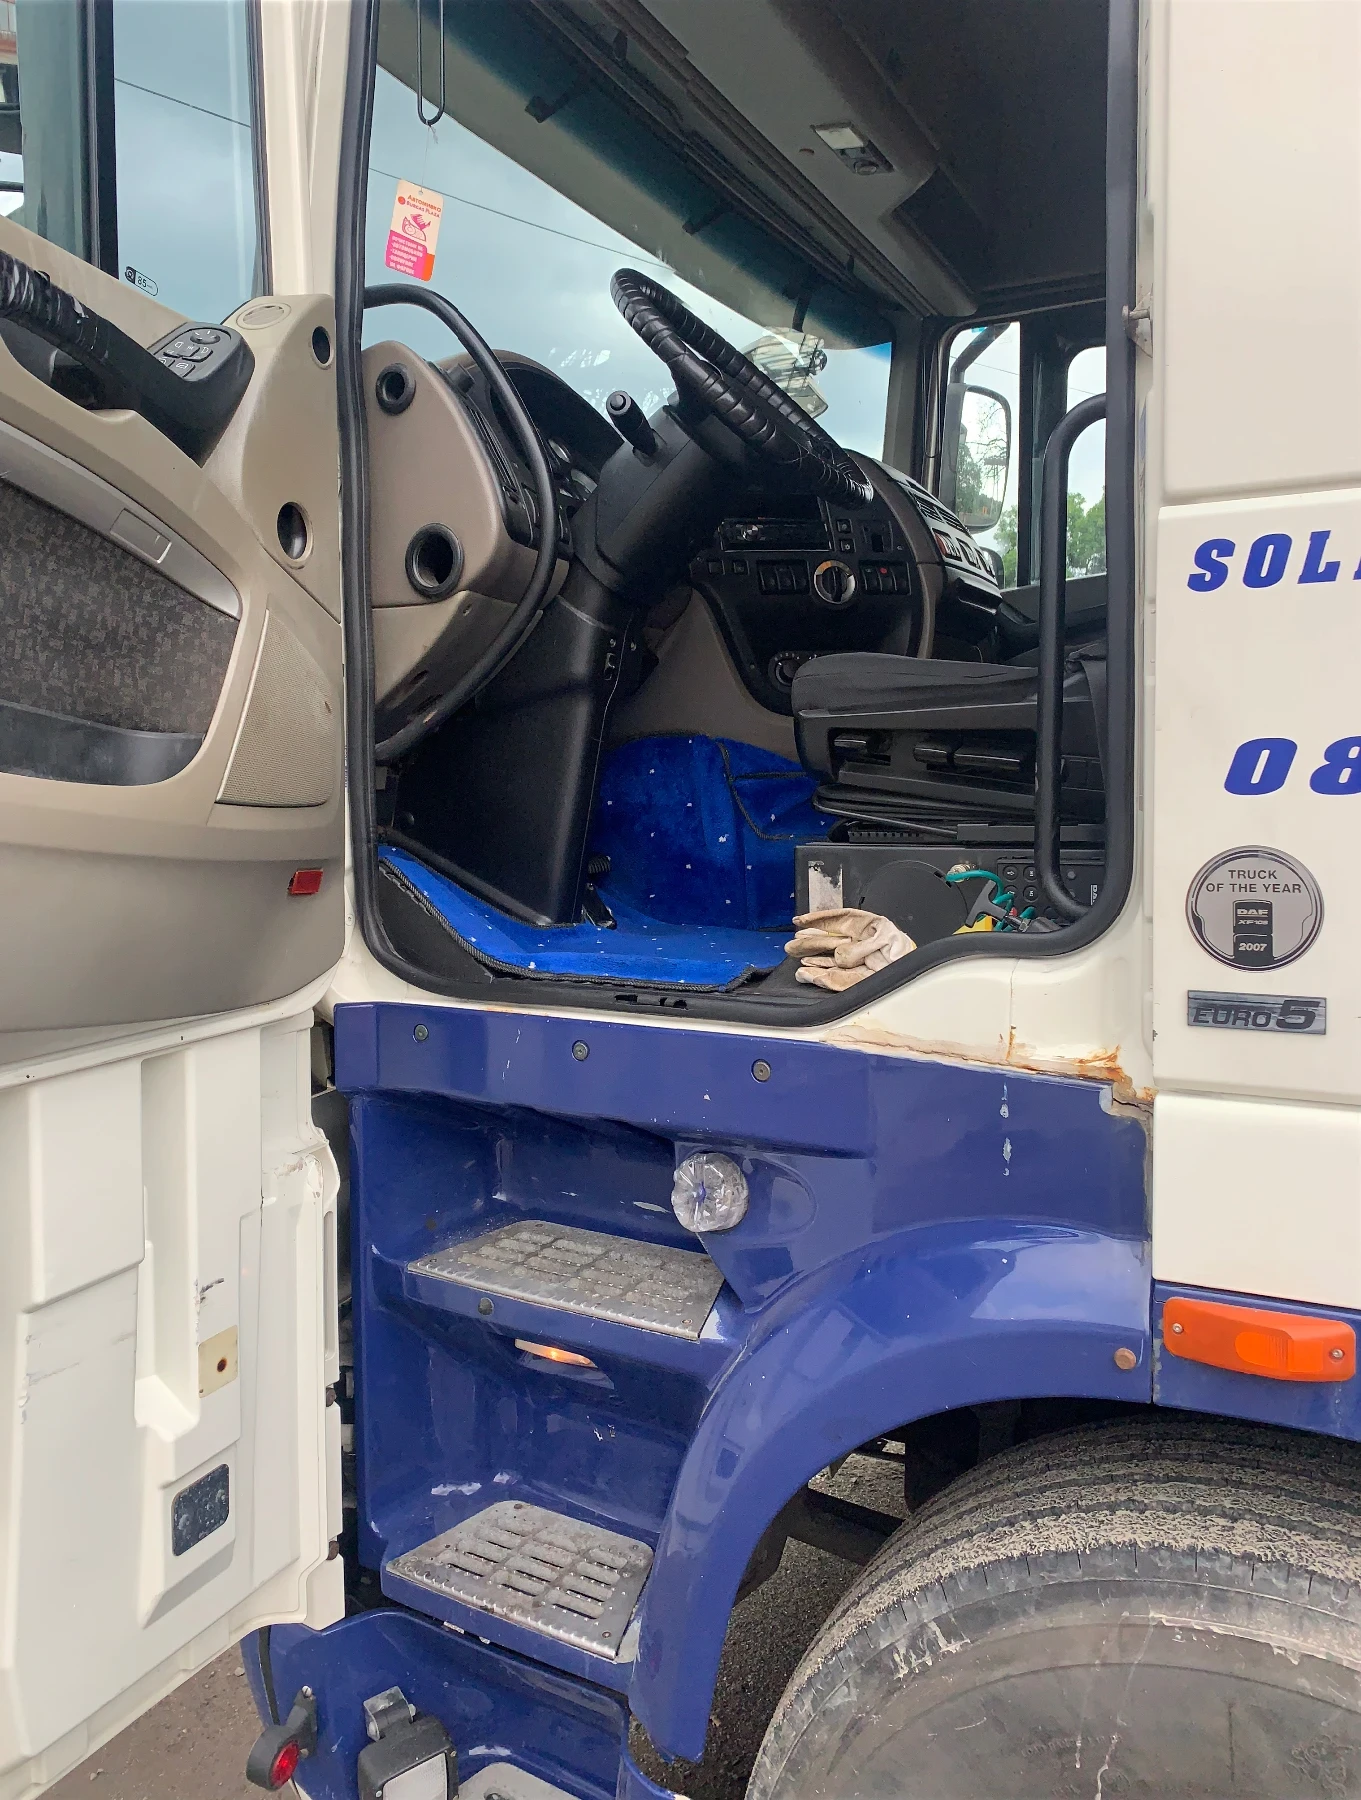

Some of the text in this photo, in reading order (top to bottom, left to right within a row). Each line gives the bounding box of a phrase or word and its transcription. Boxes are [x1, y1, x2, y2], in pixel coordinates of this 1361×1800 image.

[1228, 869, 1278, 880] TRUCK
[1206, 882, 1302, 894] OF THE YEAR
[1236, 908, 1269, 916] DAF
[1238, 942, 1268, 952] 2007
